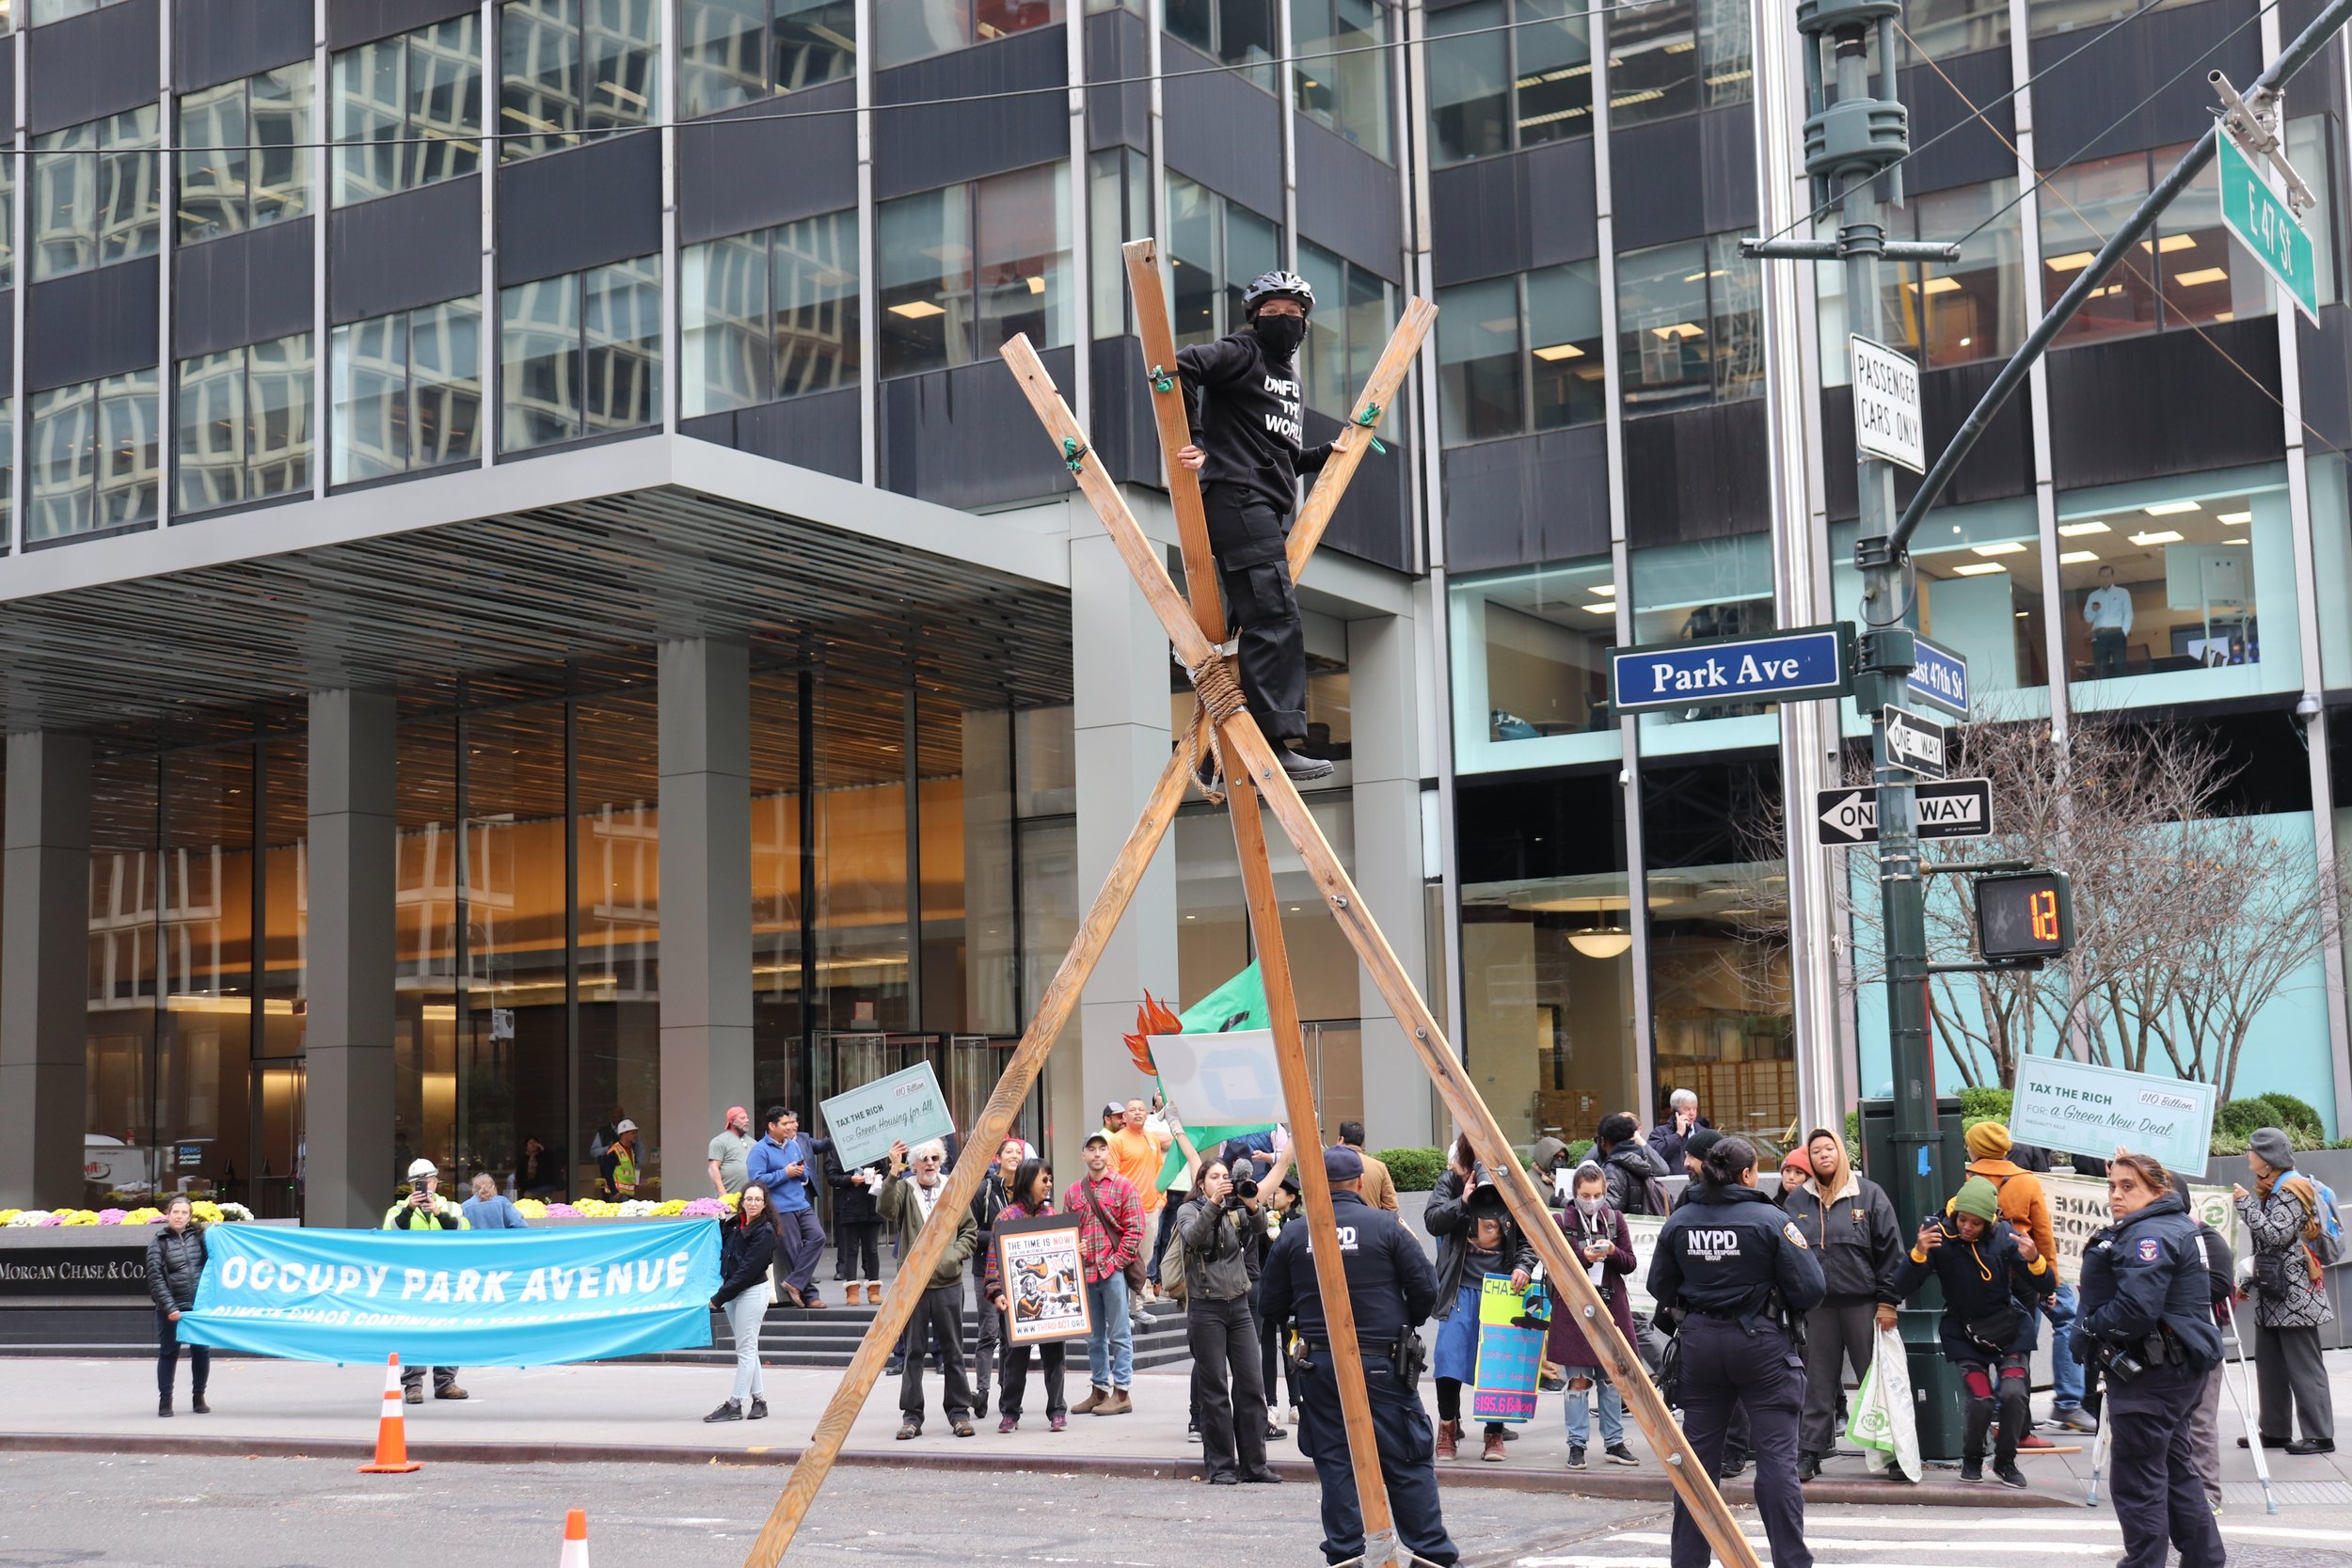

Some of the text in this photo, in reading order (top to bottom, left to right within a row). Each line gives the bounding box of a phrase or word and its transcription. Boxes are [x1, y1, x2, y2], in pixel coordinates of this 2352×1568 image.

[2249, 180, 2293, 277] E 47 St
[1858, 354, 1916, 407] PASSENGER
[1279, 399, 1300, 420] TH
[1861, 398, 1918, 449] CARS ONLY
[1651, 654, 1800, 693] Park Ave
[1930, 661, 1951, 695] 47th
[1951, 670, 1963, 701] St
[1894, 726, 1939, 761] ONE WAY
[1840, 797, 1973, 827] ON WAY
[906, 1082, 925, 1094] Billion
[2029, 1082, 2113, 1105] TAX THE RICH
[2140, 1091, 2195, 1112] $10 Billion
[835, 1103, 884, 1129] TAX THE RICH
[855, 1124, 878, 1138] Green
[879, 1111, 909, 1129] Housing
[909, 1105, 922, 1123] for
[922, 1098, 934, 1114] All
[2026, 1103, 2175, 1137] FOR: a Green New Deal
[1008, 1241, 1021, 1251] THE
[1024, 1239, 1041, 1249] TIME
[1042, 1238, 1051, 1247] IS
[1054, 1235, 1073, 1245] NOW!
[1687, 1229, 1738, 1250] NYPD
[60, 1261, 105, 1279] CHASE
[107, 1261, 119, 1279] &
[221, 1252, 690, 1303] OCCUPY PARK AVENUE
[285, 1308, 351, 1325] CHAOS
[1475, 1395, 1505, 1413] $195.6
[1506, 1396, 1533, 1414] Billion
